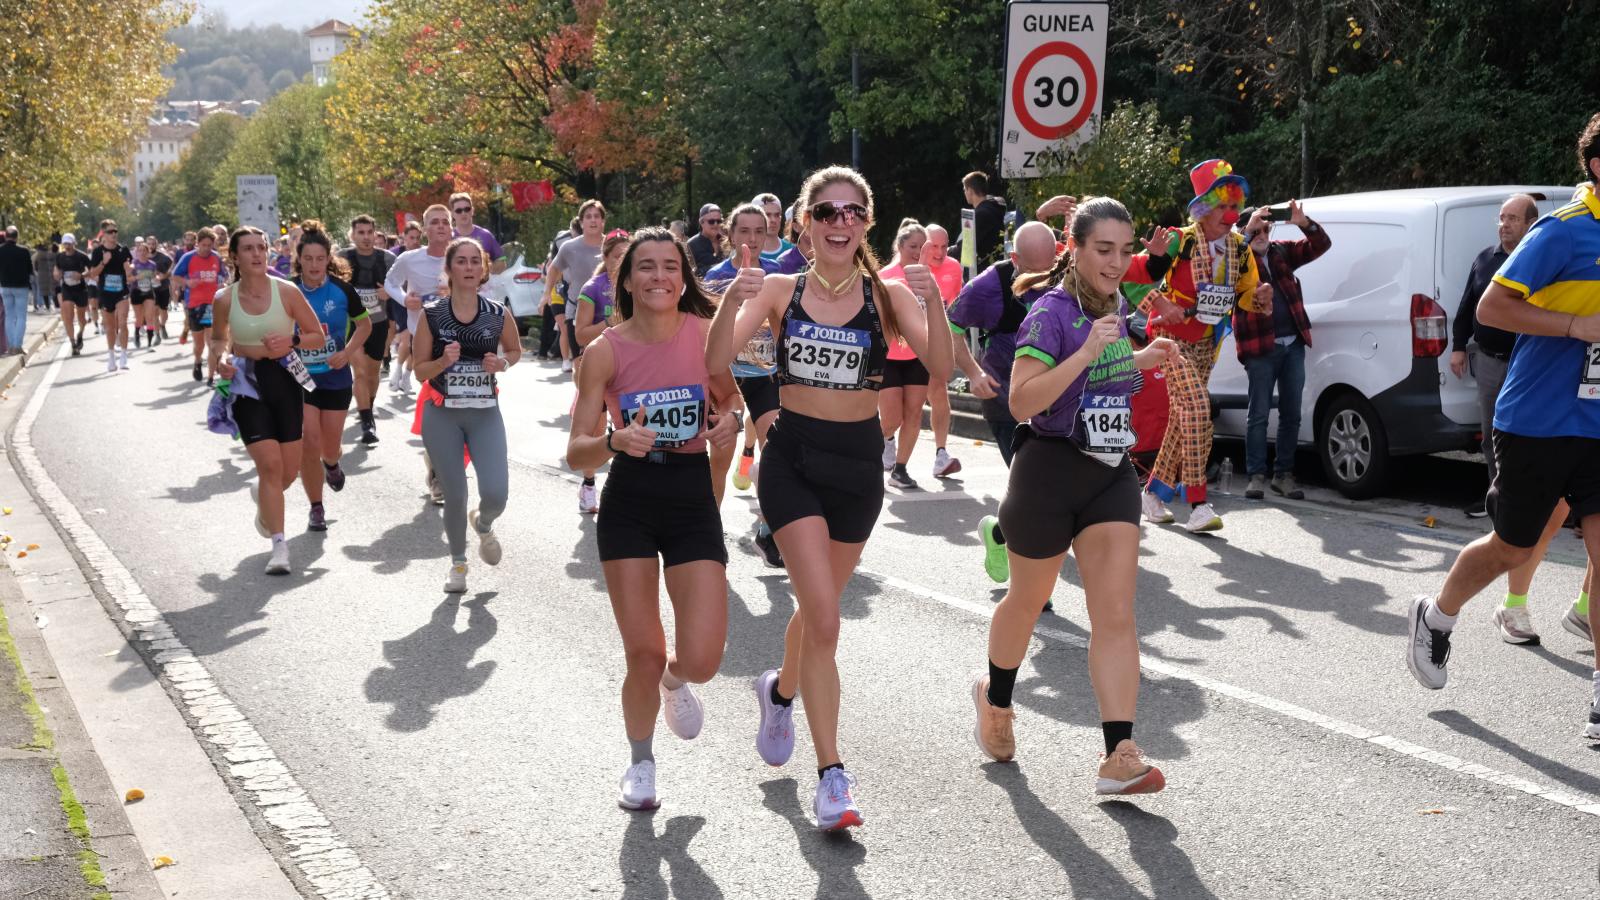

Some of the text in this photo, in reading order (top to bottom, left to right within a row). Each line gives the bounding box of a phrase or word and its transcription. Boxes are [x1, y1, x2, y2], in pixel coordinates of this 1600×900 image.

[1024, 15, 1094, 32] GUNEA
[1033, 76, 1079, 108] 30
[1200, 293, 1234, 306] 20264
[789, 342, 861, 370] 23579
[449, 375, 490, 387] 22604
[814, 371, 830, 380] EVA
[655, 431, 679, 440] PAULA
